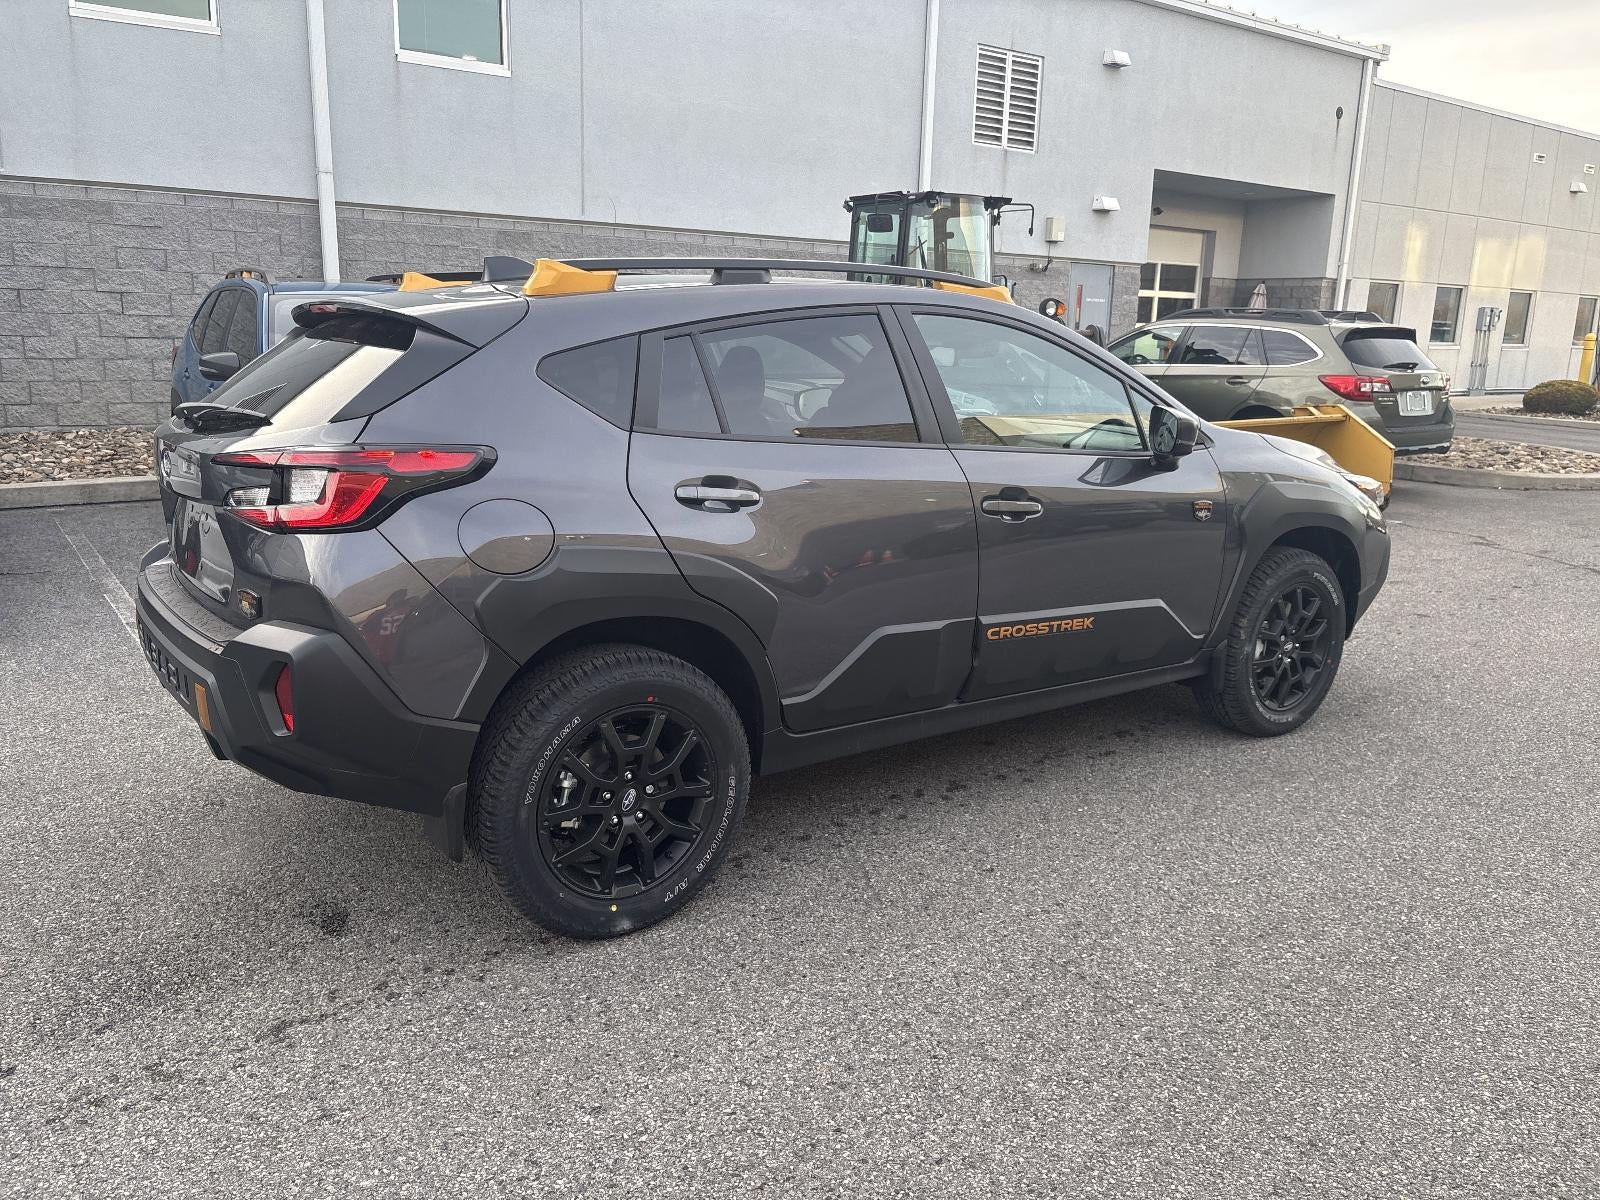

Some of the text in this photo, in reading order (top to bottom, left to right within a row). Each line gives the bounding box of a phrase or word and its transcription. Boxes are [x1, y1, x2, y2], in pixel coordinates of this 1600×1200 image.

[987, 617, 1095, 640] CROSSTREK
[524, 716, 581, 805] YOKOHAMA
[695, 775, 737, 873] GEOLANDAR
